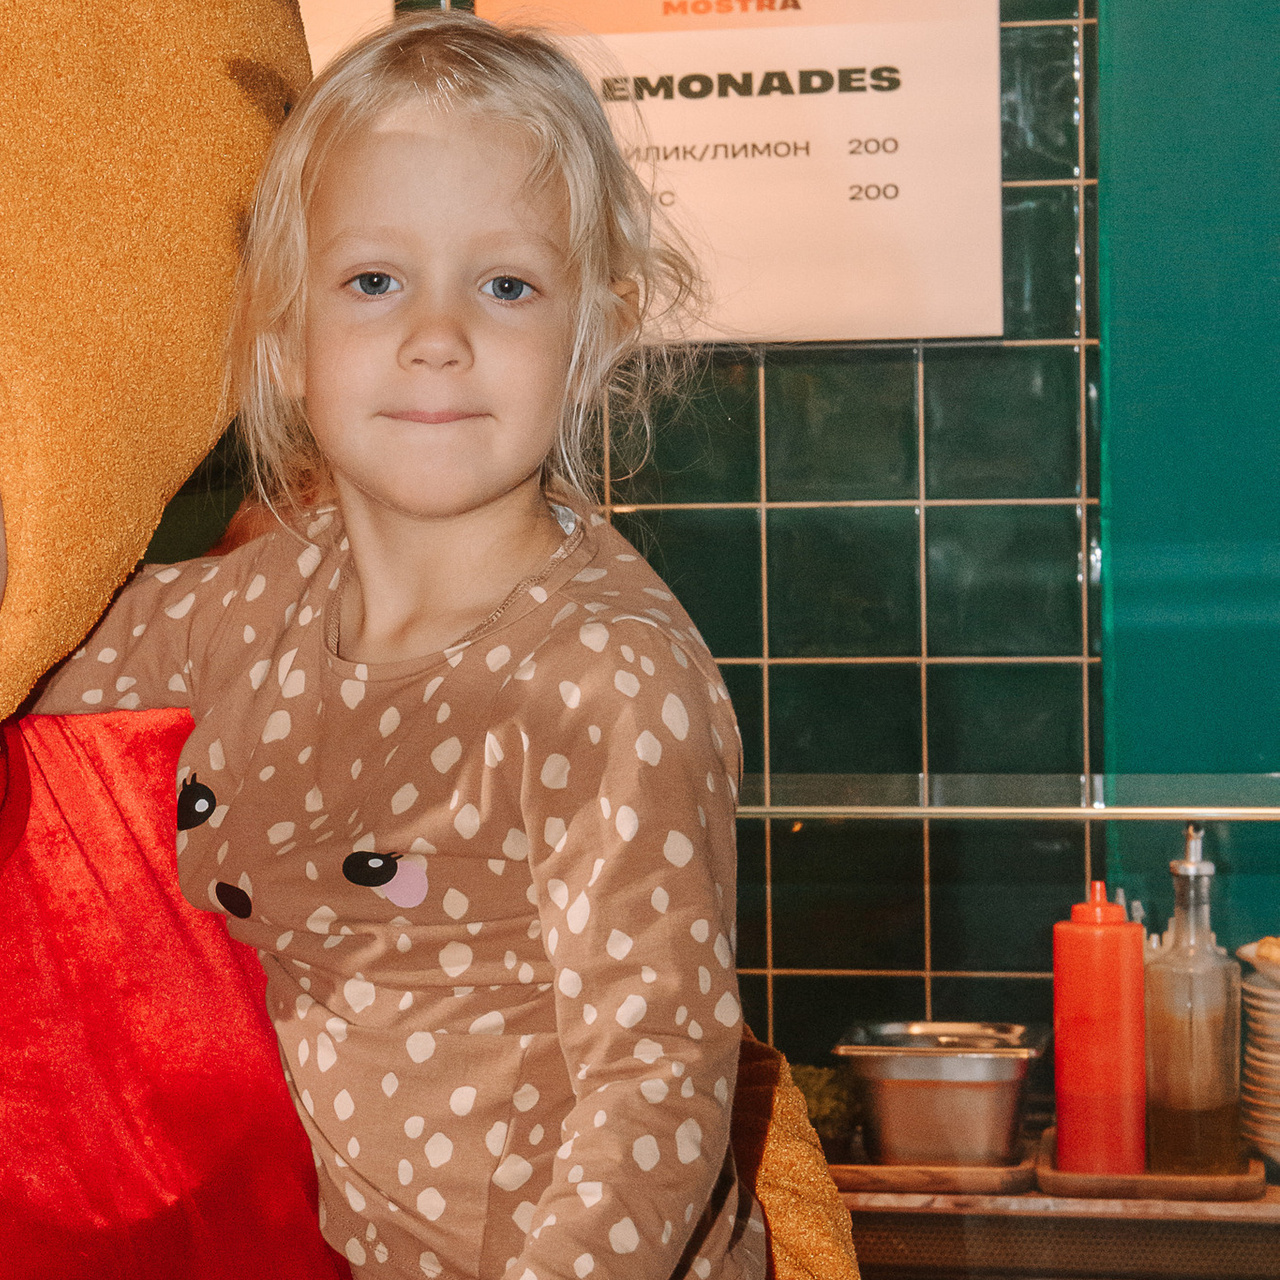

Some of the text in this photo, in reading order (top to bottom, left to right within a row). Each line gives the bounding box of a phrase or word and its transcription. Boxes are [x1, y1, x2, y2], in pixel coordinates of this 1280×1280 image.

[601, 65, 903, 103] EMONADES
[623, 136, 900, 163] ИЛИК/ЛИМОН 200
[847, 182, 901, 203] 200
